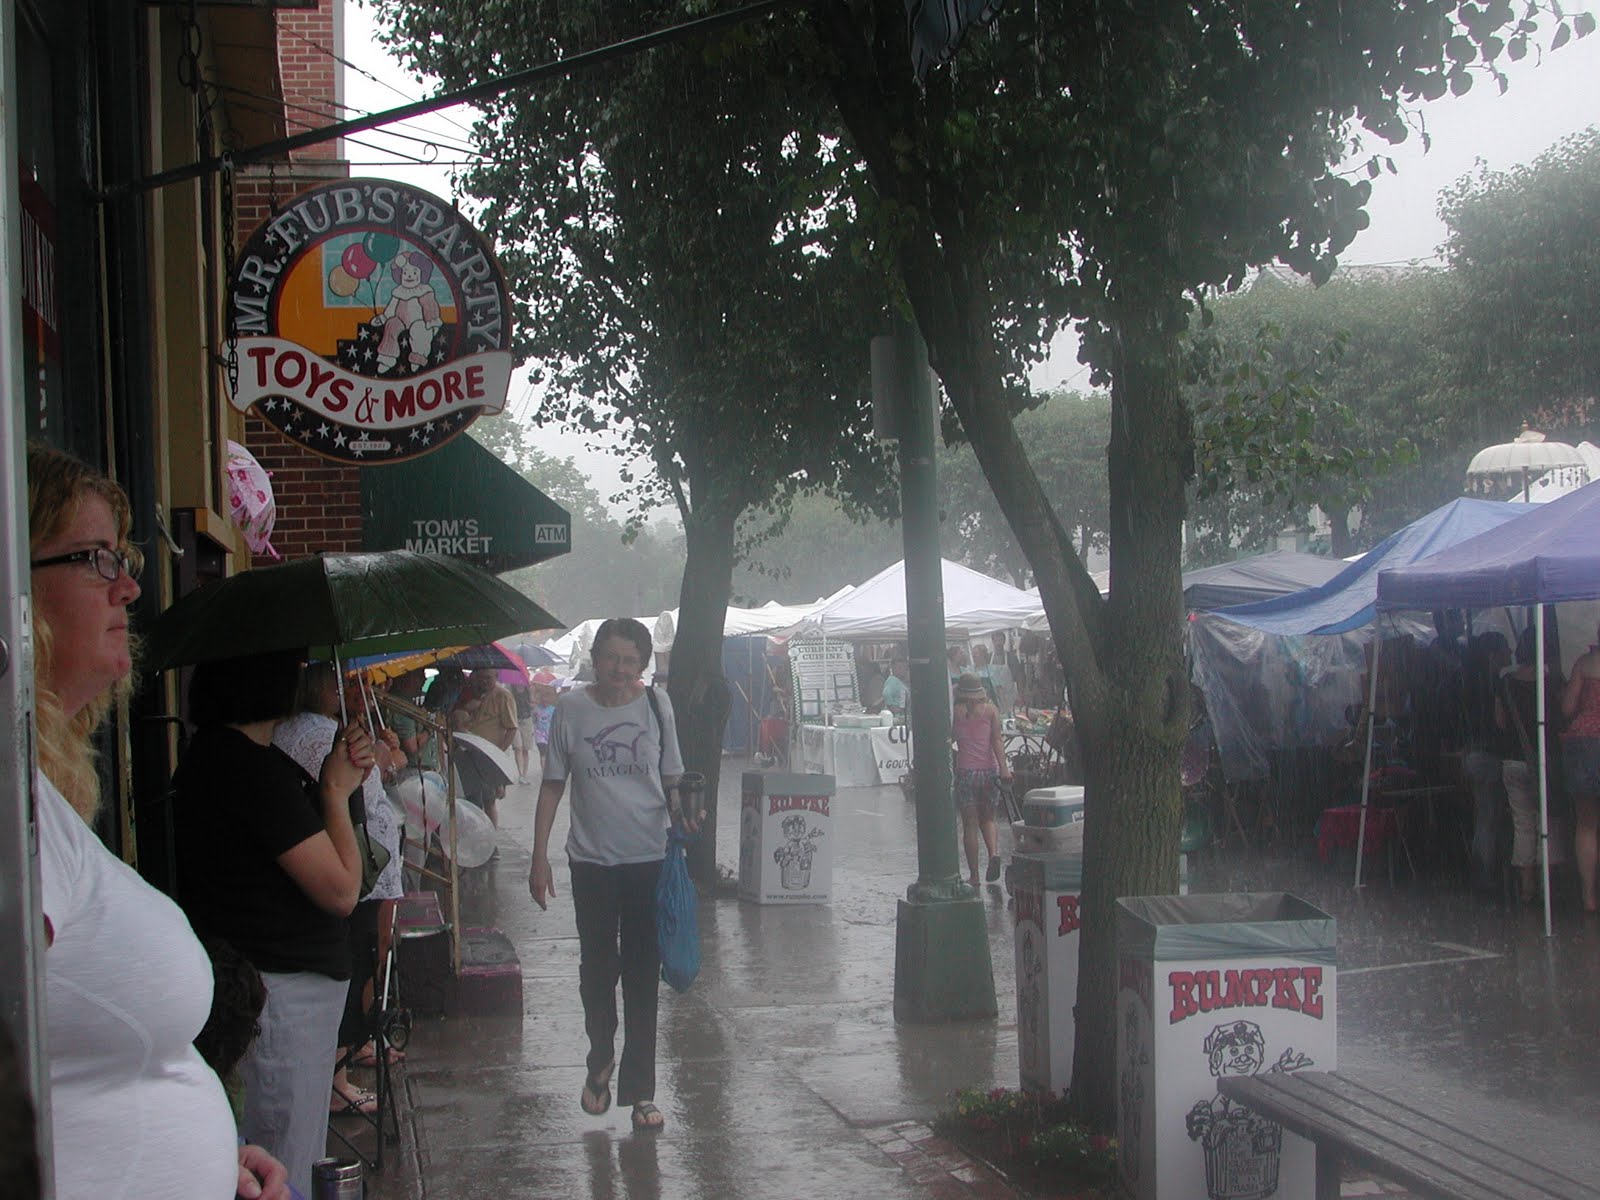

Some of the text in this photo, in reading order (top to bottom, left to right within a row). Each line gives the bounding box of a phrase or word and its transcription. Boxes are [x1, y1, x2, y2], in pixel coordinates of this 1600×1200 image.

[233, 186, 501, 348] MR. FUB'S PARTY
[247, 346, 486, 424] TOYS & MORE
[405, 536, 493, 554] MARKET
[413, 519, 479, 537] TOM'S
[537, 527, 566, 542] ATM
[1056, 895, 1081, 937] R
[1168, 966, 1324, 1025] RUMPKE
